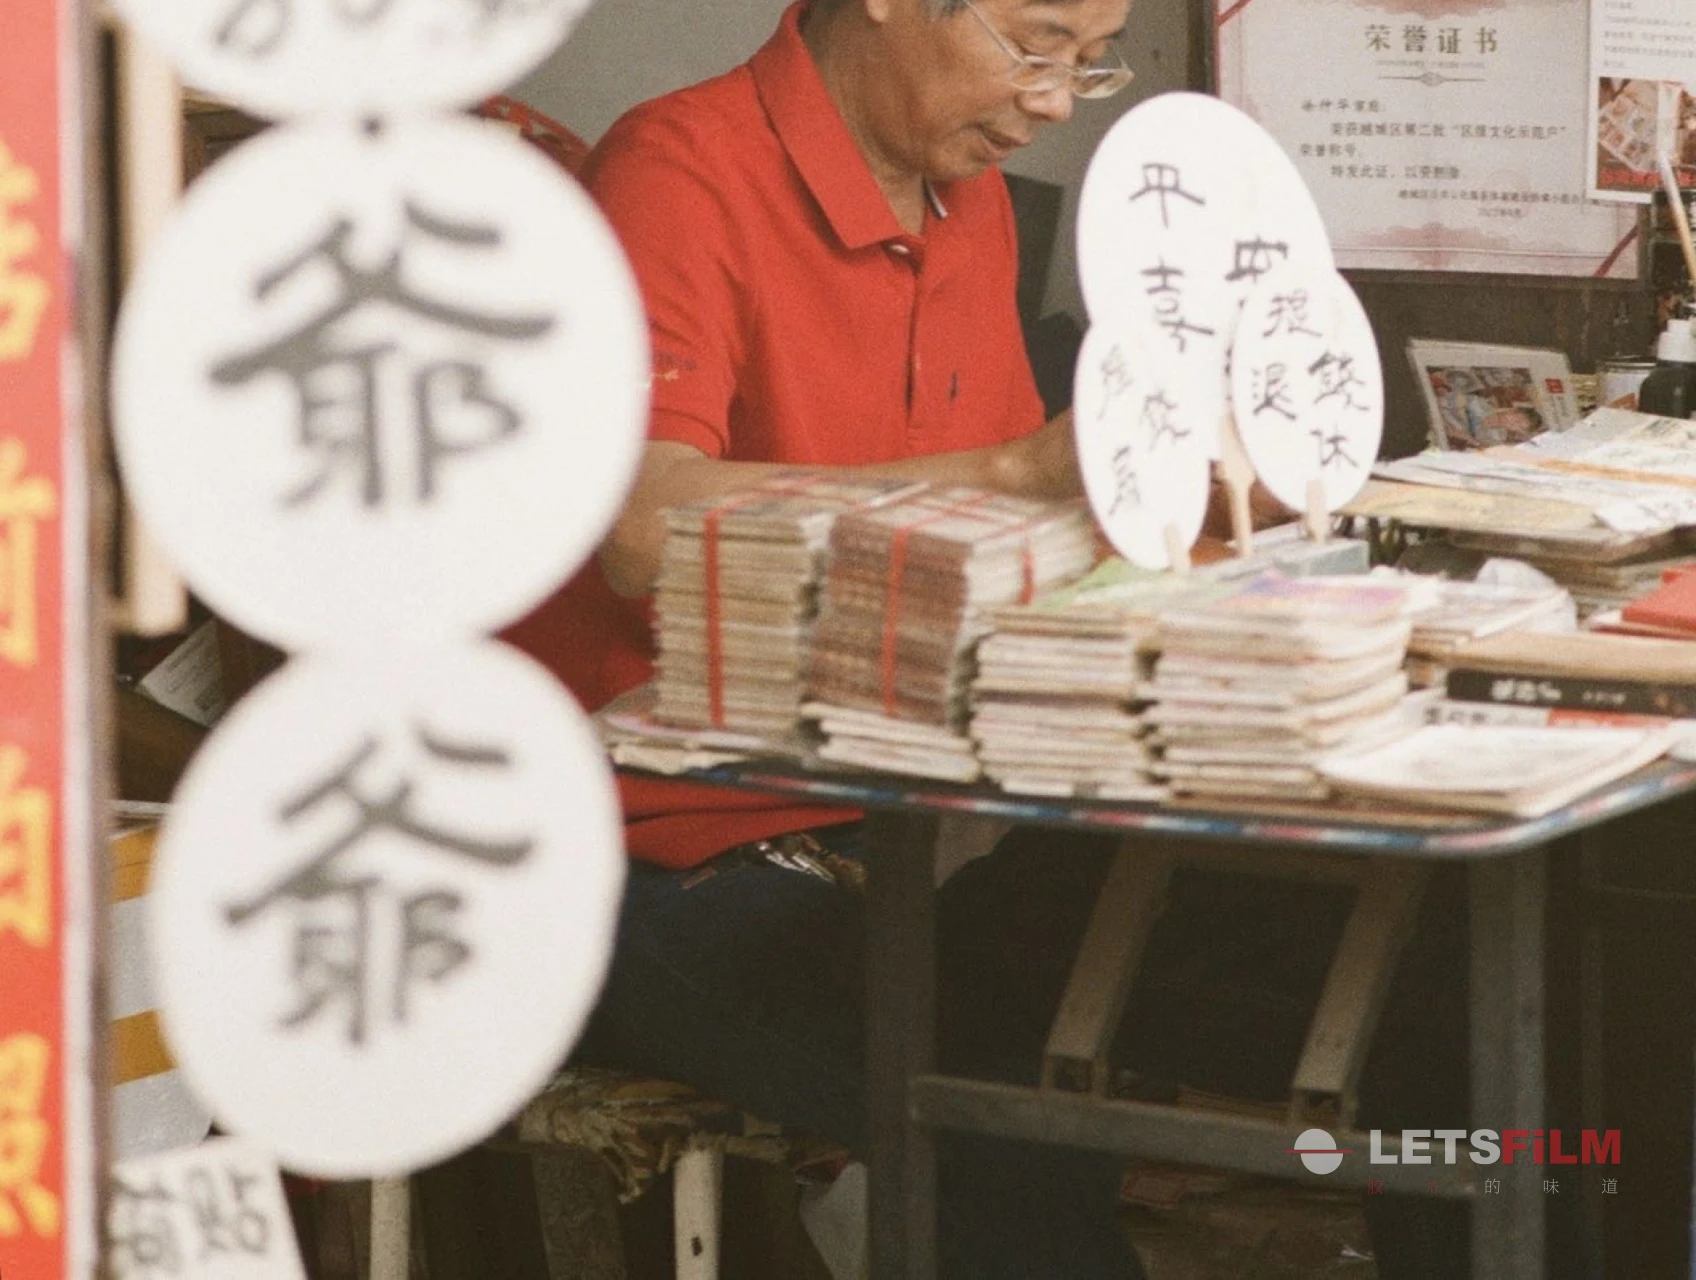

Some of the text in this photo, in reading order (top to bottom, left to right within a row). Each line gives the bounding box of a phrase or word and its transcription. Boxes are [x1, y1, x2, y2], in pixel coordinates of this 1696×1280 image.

[1364, 23, 1499, 55] 荣誉证书
[210, 190, 558, 508] 爺
[223, 714, 536, 1050] 爺
